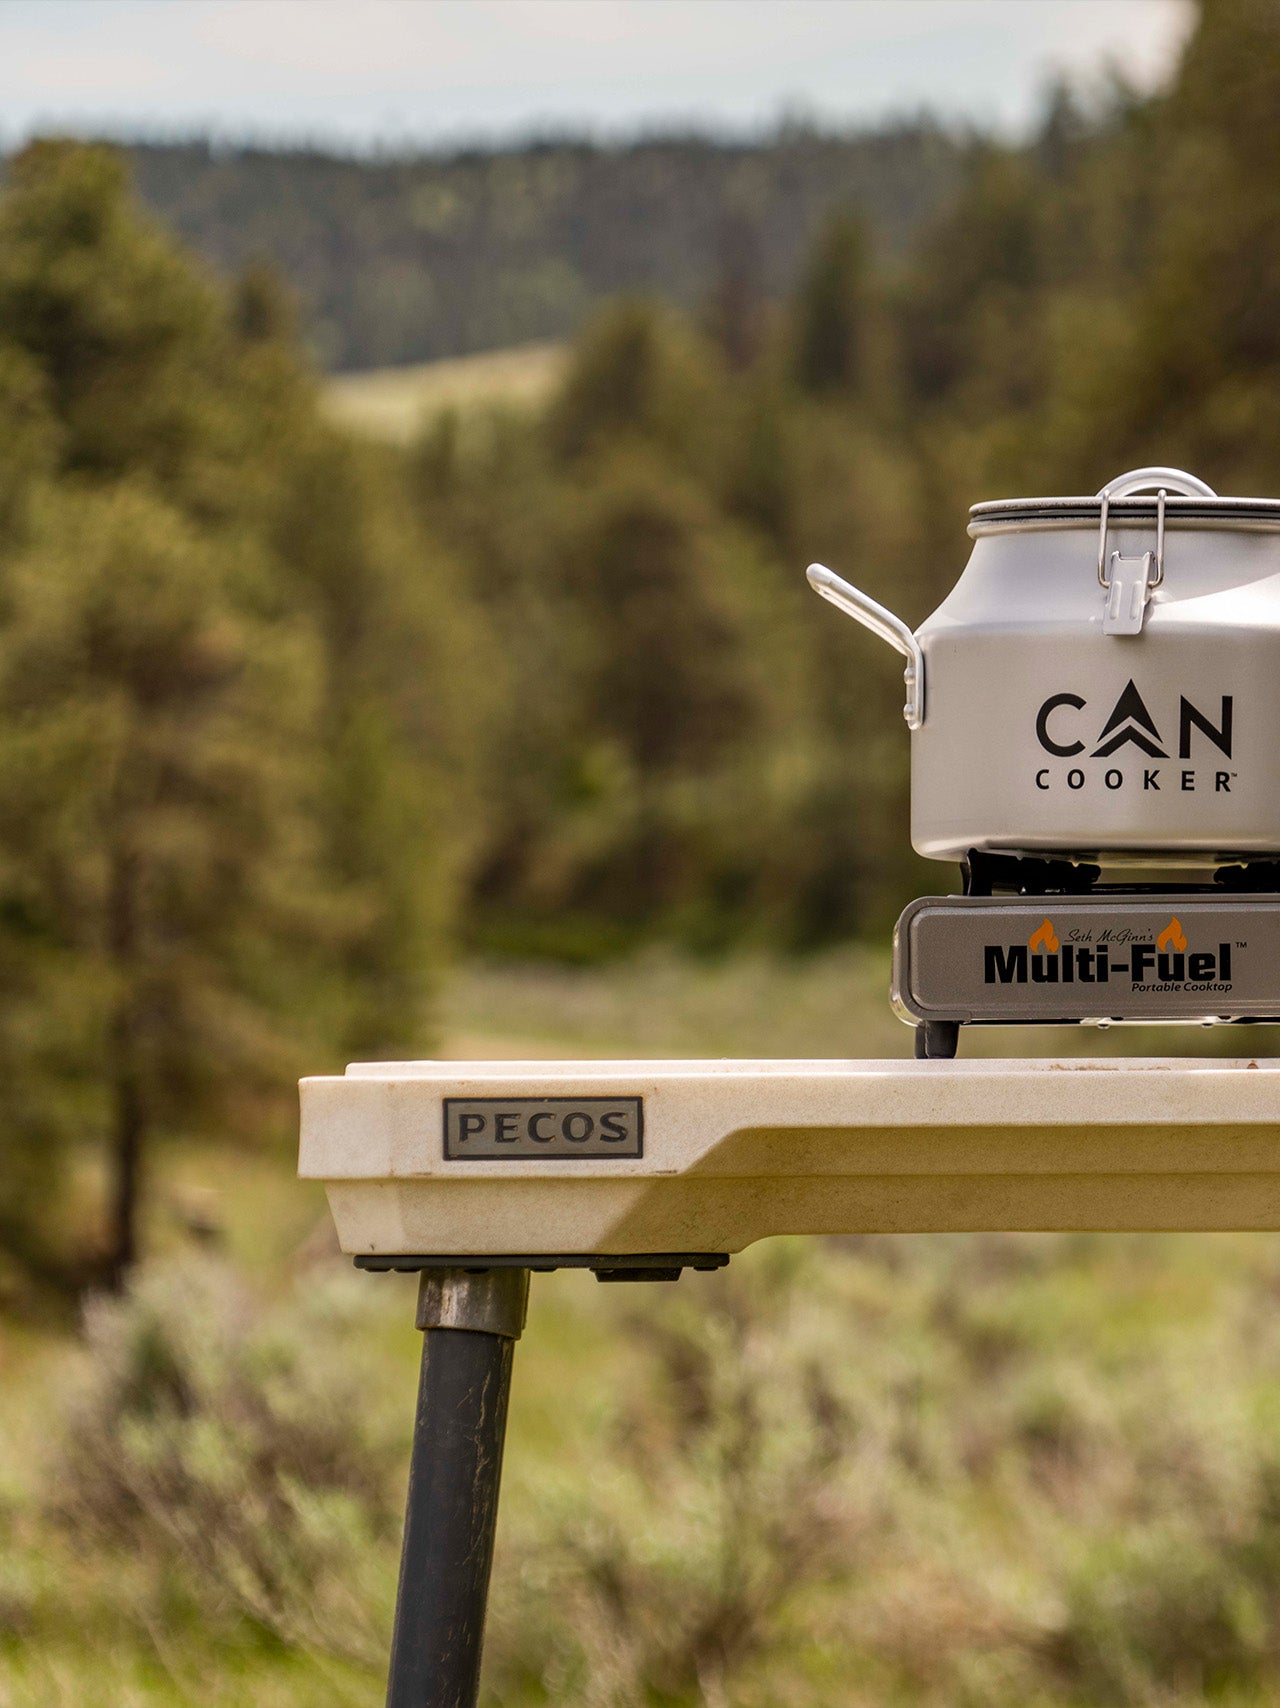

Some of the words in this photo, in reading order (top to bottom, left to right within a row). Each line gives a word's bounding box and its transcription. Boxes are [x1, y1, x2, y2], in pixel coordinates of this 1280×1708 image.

[1035, 678, 1234, 760] CAN
[1035, 768, 1232, 793] COOKER
[1064, 928, 1093, 943] Seth
[984, 943, 1232, 984] Multi-Fuel
[1131, 982, 1181, 993] Portable
[1183, 982, 1233, 993] Cooktop
[457, 1111, 629, 1144] PECOS
